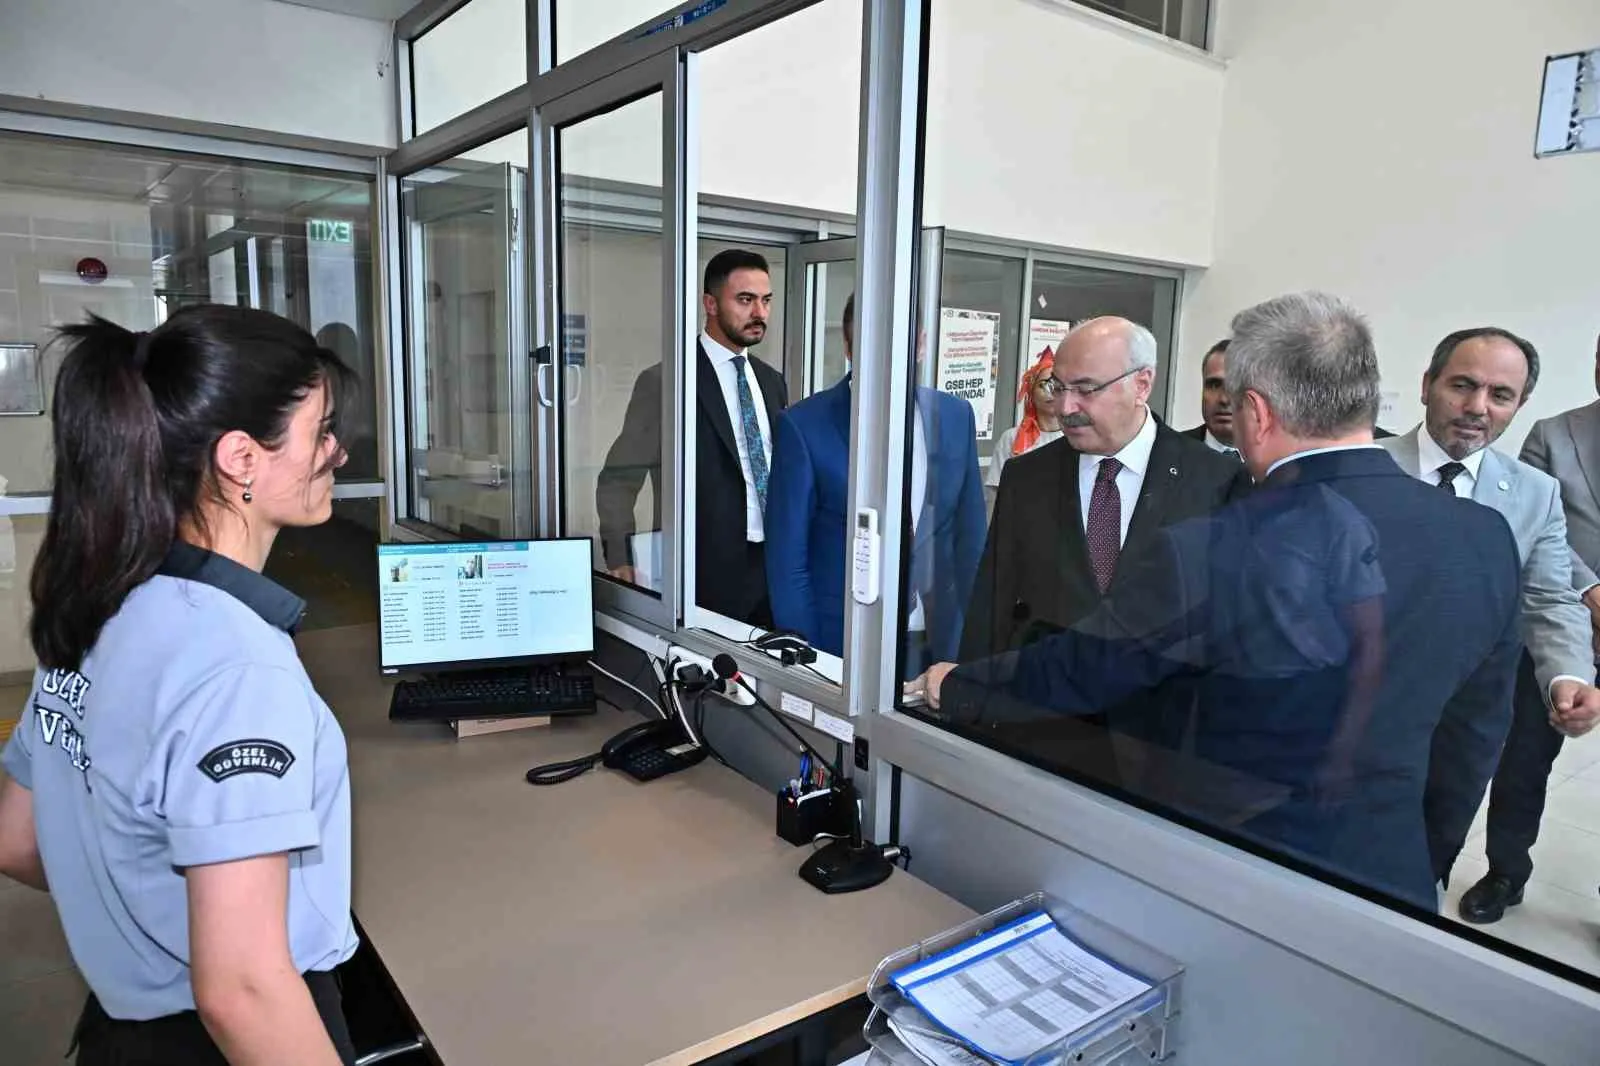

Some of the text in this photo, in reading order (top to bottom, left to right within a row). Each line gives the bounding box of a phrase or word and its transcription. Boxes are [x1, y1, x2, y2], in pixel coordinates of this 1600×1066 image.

[945, 376, 984, 391] GSB HEP
[949, 388, 985, 401] NINDA!
[232, 746, 267, 759] ÖZEL
[213, 756, 284, 773] GÜVENLİK
